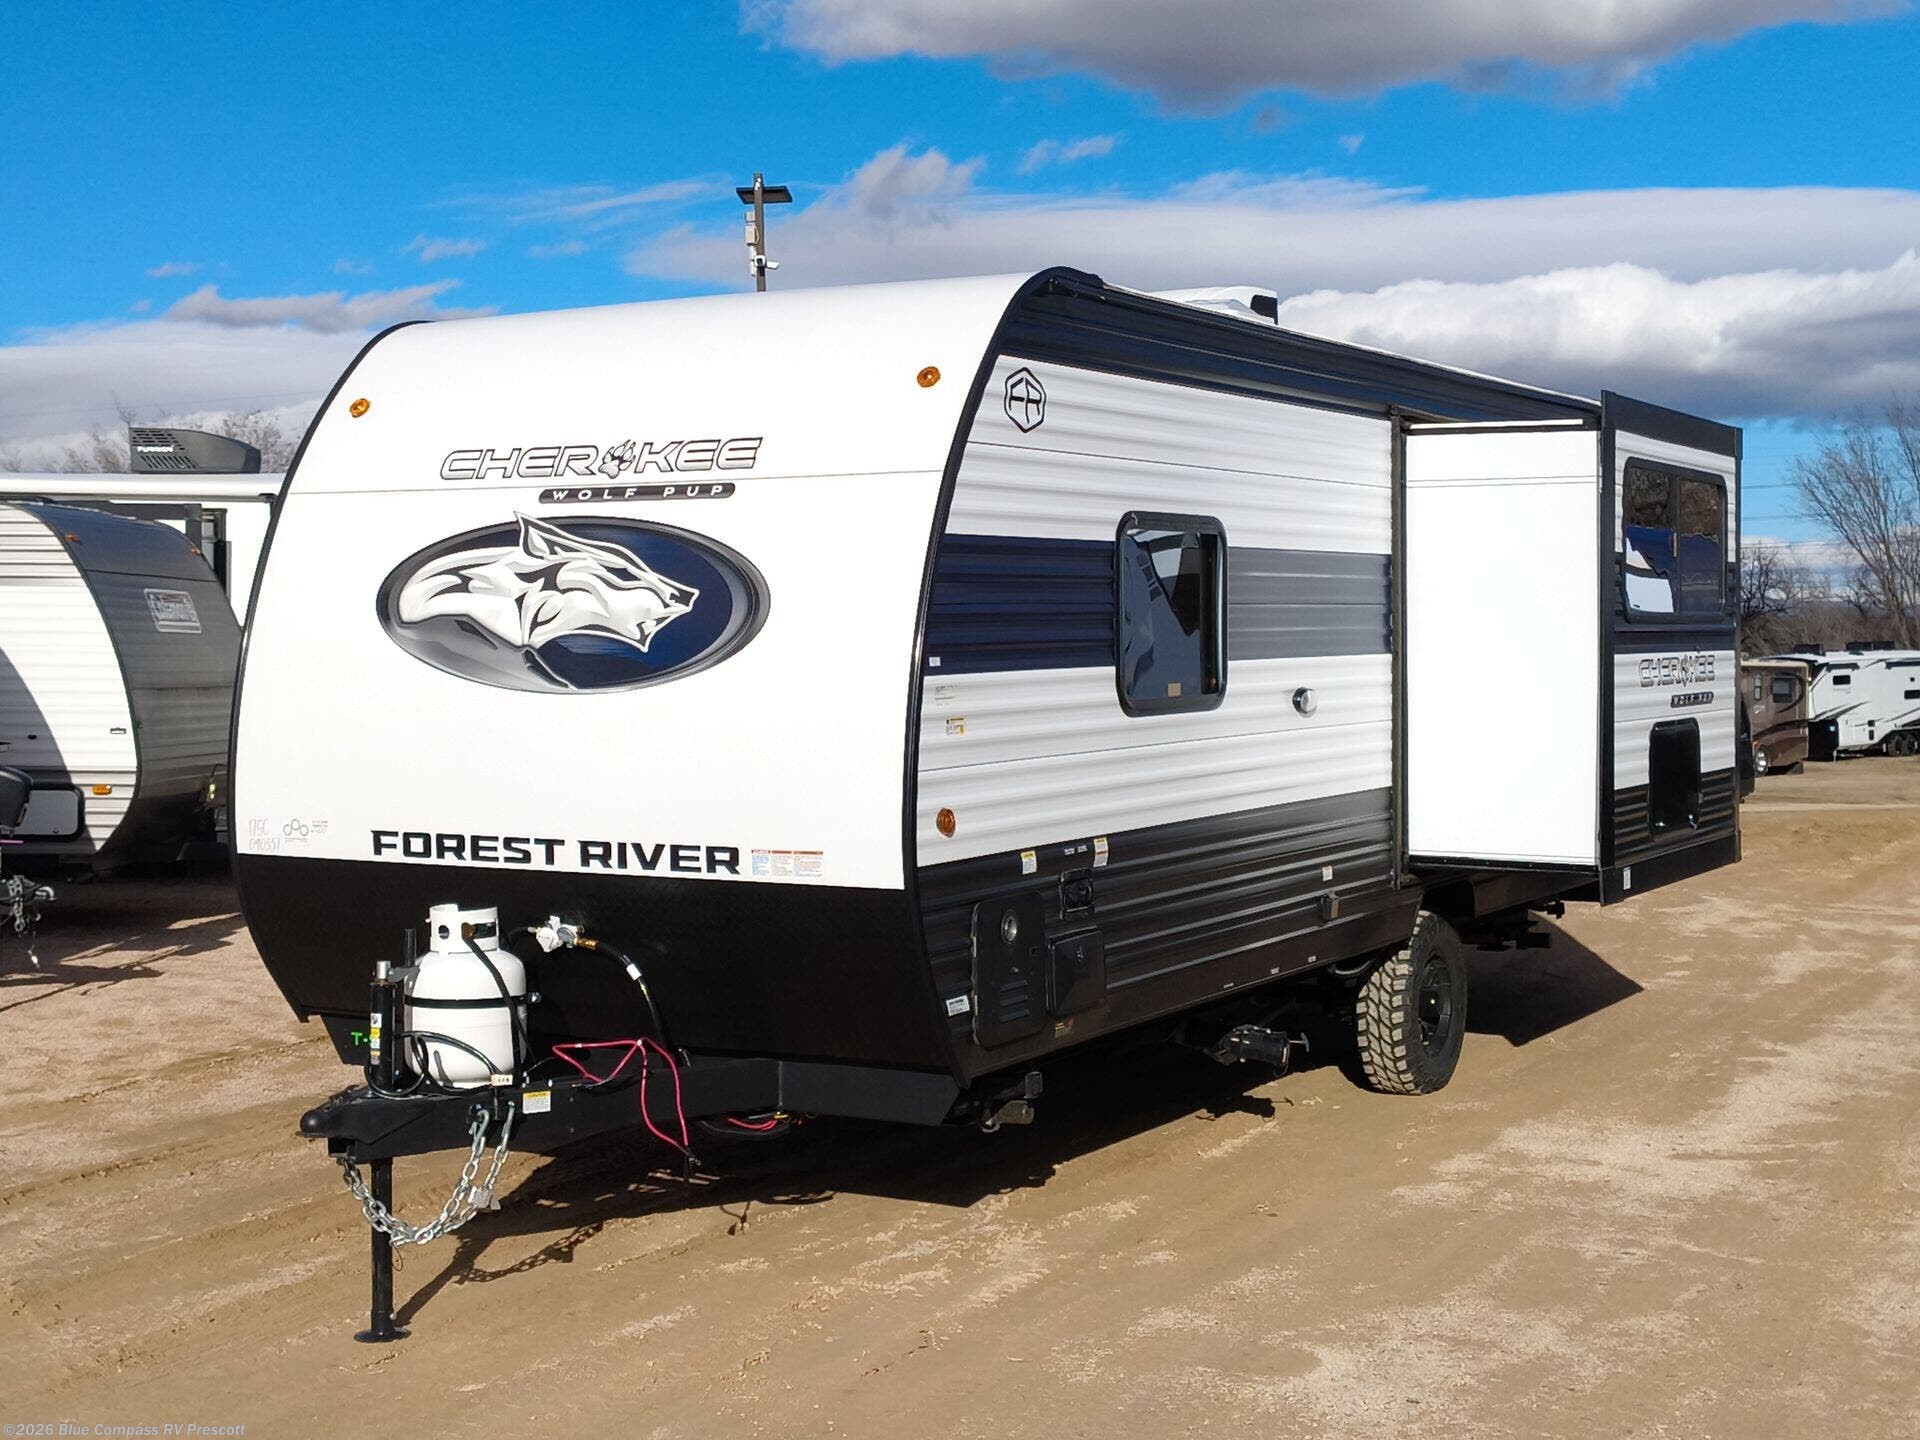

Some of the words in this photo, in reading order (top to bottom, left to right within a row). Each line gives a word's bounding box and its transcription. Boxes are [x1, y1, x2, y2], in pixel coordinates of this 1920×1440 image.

[552, 487, 637, 501] WOLF
[663, 484, 723, 498] PUP
[371, 830, 565, 866] FOREST
[577, 840, 741, 876] RIVER
